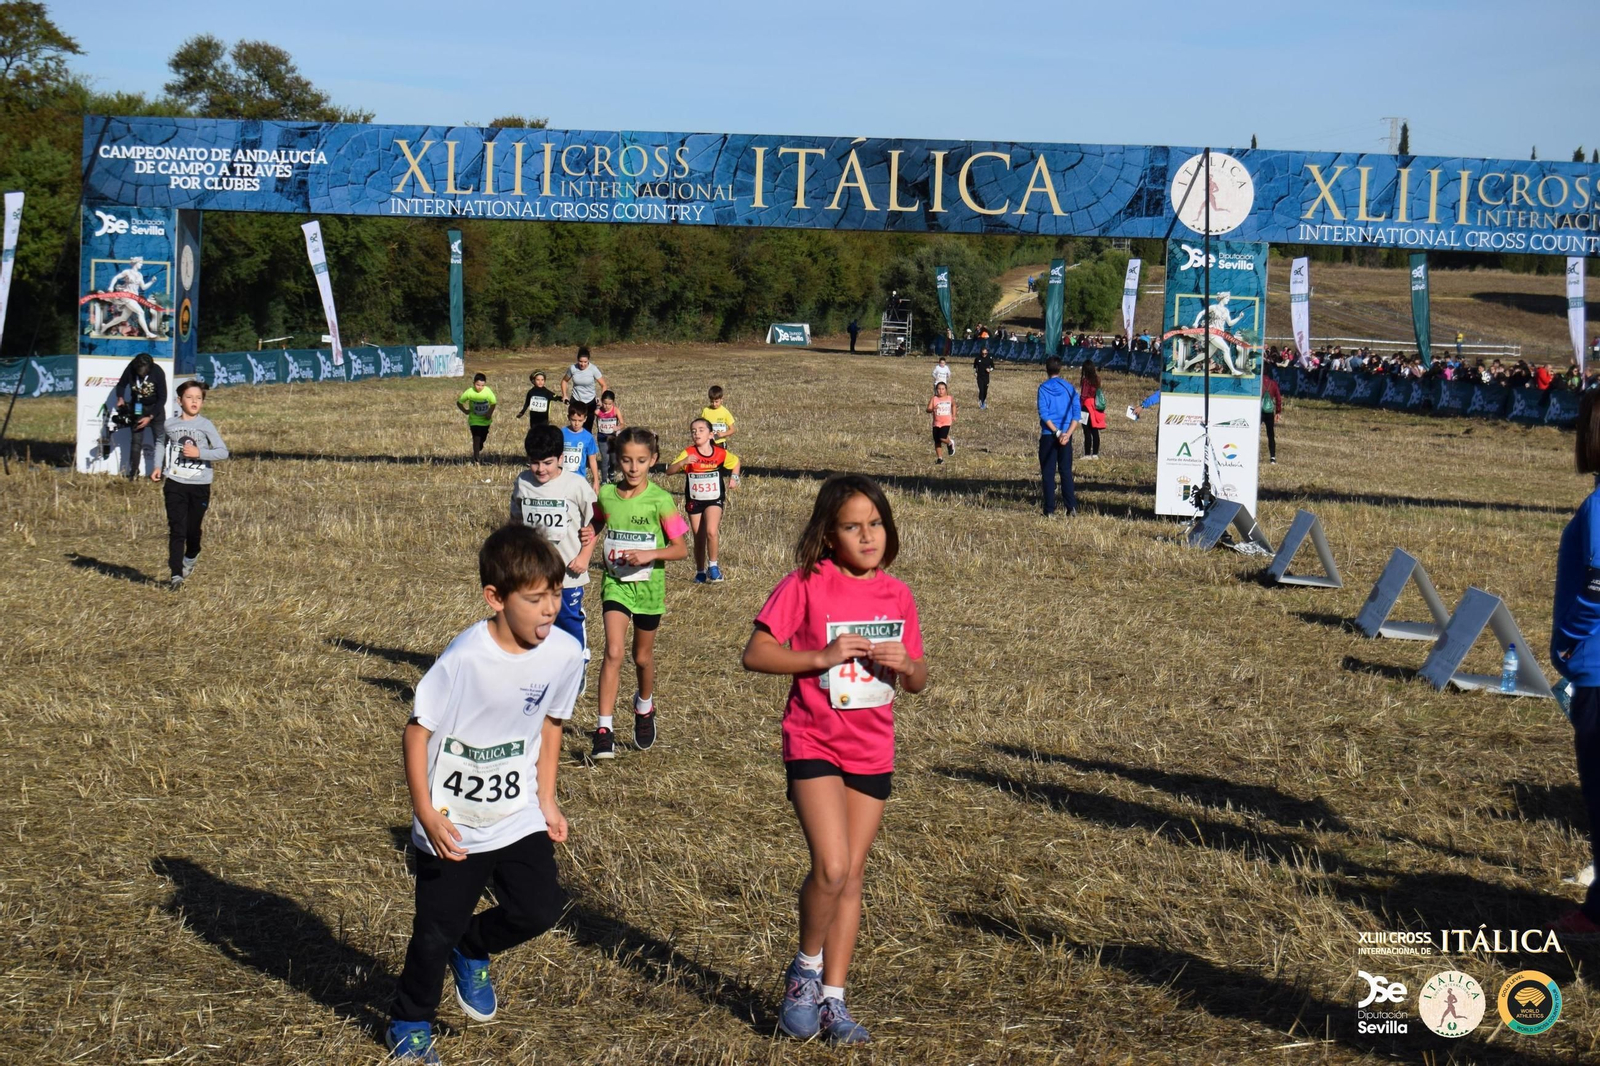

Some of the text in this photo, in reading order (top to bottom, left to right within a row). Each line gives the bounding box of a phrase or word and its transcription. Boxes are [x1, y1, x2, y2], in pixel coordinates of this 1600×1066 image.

[99, 145, 327, 165] CAMPEONATO DE ANDALUCÍA
[135, 161, 292, 178] DE CAMPO A TRAVÉS
[391, 140, 690, 197] XLIII CROSS
[170, 176, 260, 191] POR CLUBES
[750, 137, 1069, 217] ITÁLICA
[561, 180, 737, 201] INTERNACIONAL
[1301, 164, 1600, 225] XLIII CROS
[390, 198, 705, 221] INTERNATIONAL CROSS COUNTRY
[131, 225, 165, 236] Sevilla
[1300, 224, 1460, 247] INTERNATIONAL
[1466, 231, 1525, 249] CROSS
[1218, 252, 1254, 260] Diputación
[1218, 260, 1254, 270] Sevilla
[174, 457, 205, 471] 4122
[563, 455, 580, 464] 160
[692, 482, 718, 493] 4531
[526, 512, 564, 528] 4202
[616, 532, 642, 541] ITÁLICA
[854, 624, 891, 637] ITÁLICA
[468, 747, 506, 761] ITÁLICA
[442, 770, 521, 803] 4238
